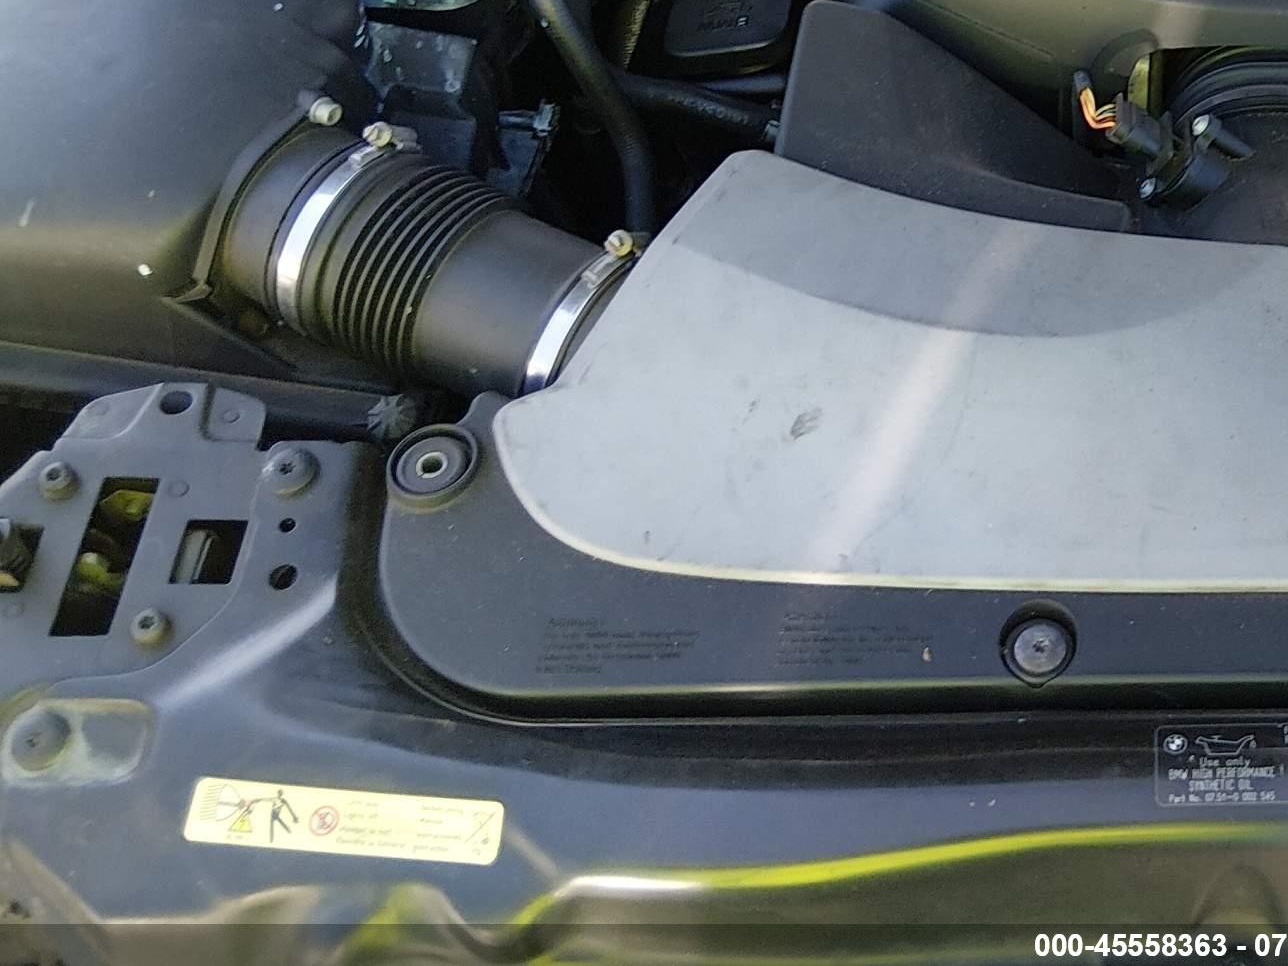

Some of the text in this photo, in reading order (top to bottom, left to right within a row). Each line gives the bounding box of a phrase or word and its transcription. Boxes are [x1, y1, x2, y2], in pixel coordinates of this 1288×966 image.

[1200, 756, 1251, 768] Use only
[1168, 768, 1188, 780] BMW
[1216, 765, 1276, 779] PERFORMANCE
[1188, 778, 1254, 792] SYNTHETIC OIL
[1168, 794, 1186, 803] Part
